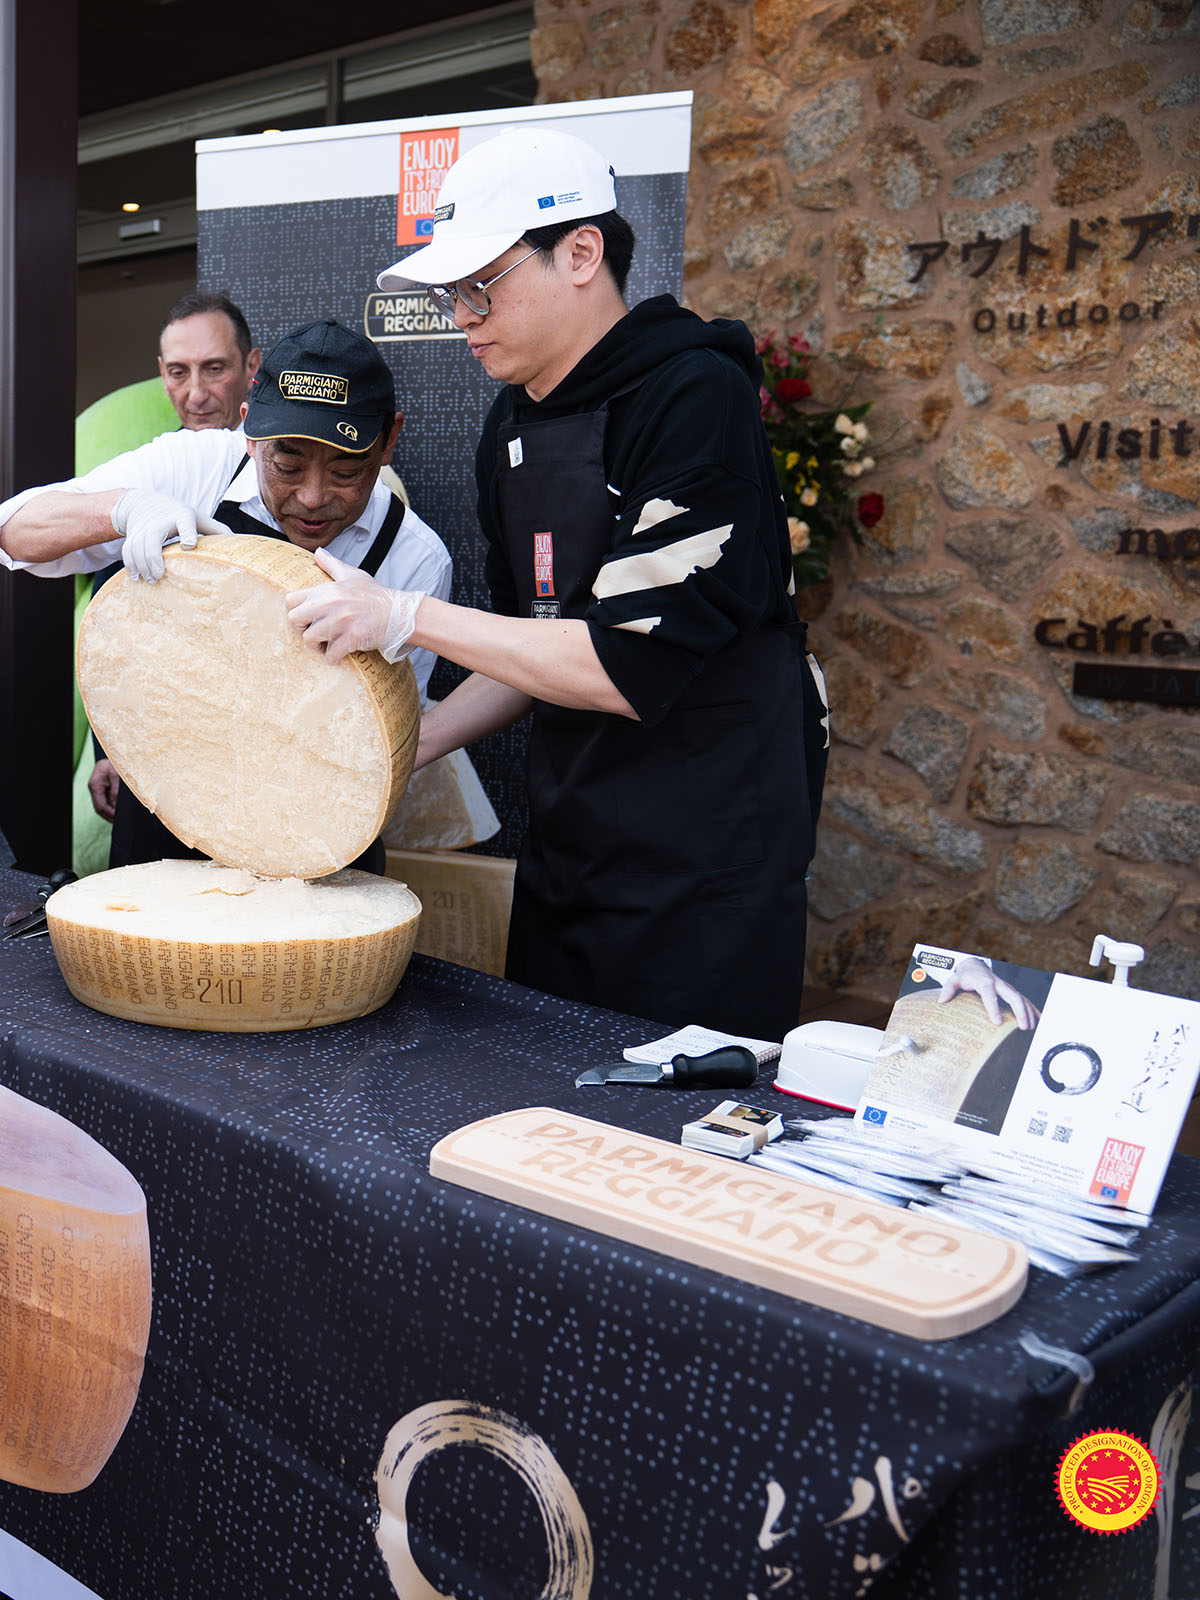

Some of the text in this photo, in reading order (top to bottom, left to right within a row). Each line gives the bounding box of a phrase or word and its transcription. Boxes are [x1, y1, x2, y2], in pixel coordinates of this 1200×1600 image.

[403, 136, 457, 172] ENJOY
[404, 170, 425, 191] IT'S
[403, 189, 438, 216] EURO
[374, 296, 441, 317] PARMIG
[973, 300, 1166, 334] Outdoor
[283, 374, 346, 393] PARMIGIANO
[287, 384, 338, 401] REGGIANO
[1056, 417, 1200, 462] Visit
[197, 977, 243, 1005] 210
[1104, 1139, 1143, 1165] ENJOY
[525, 1121, 962, 1258] PARMIGIANO
[1095, 1167, 1134, 1192] EUROPE
[518, 1149, 880, 1268] REGGIANO
